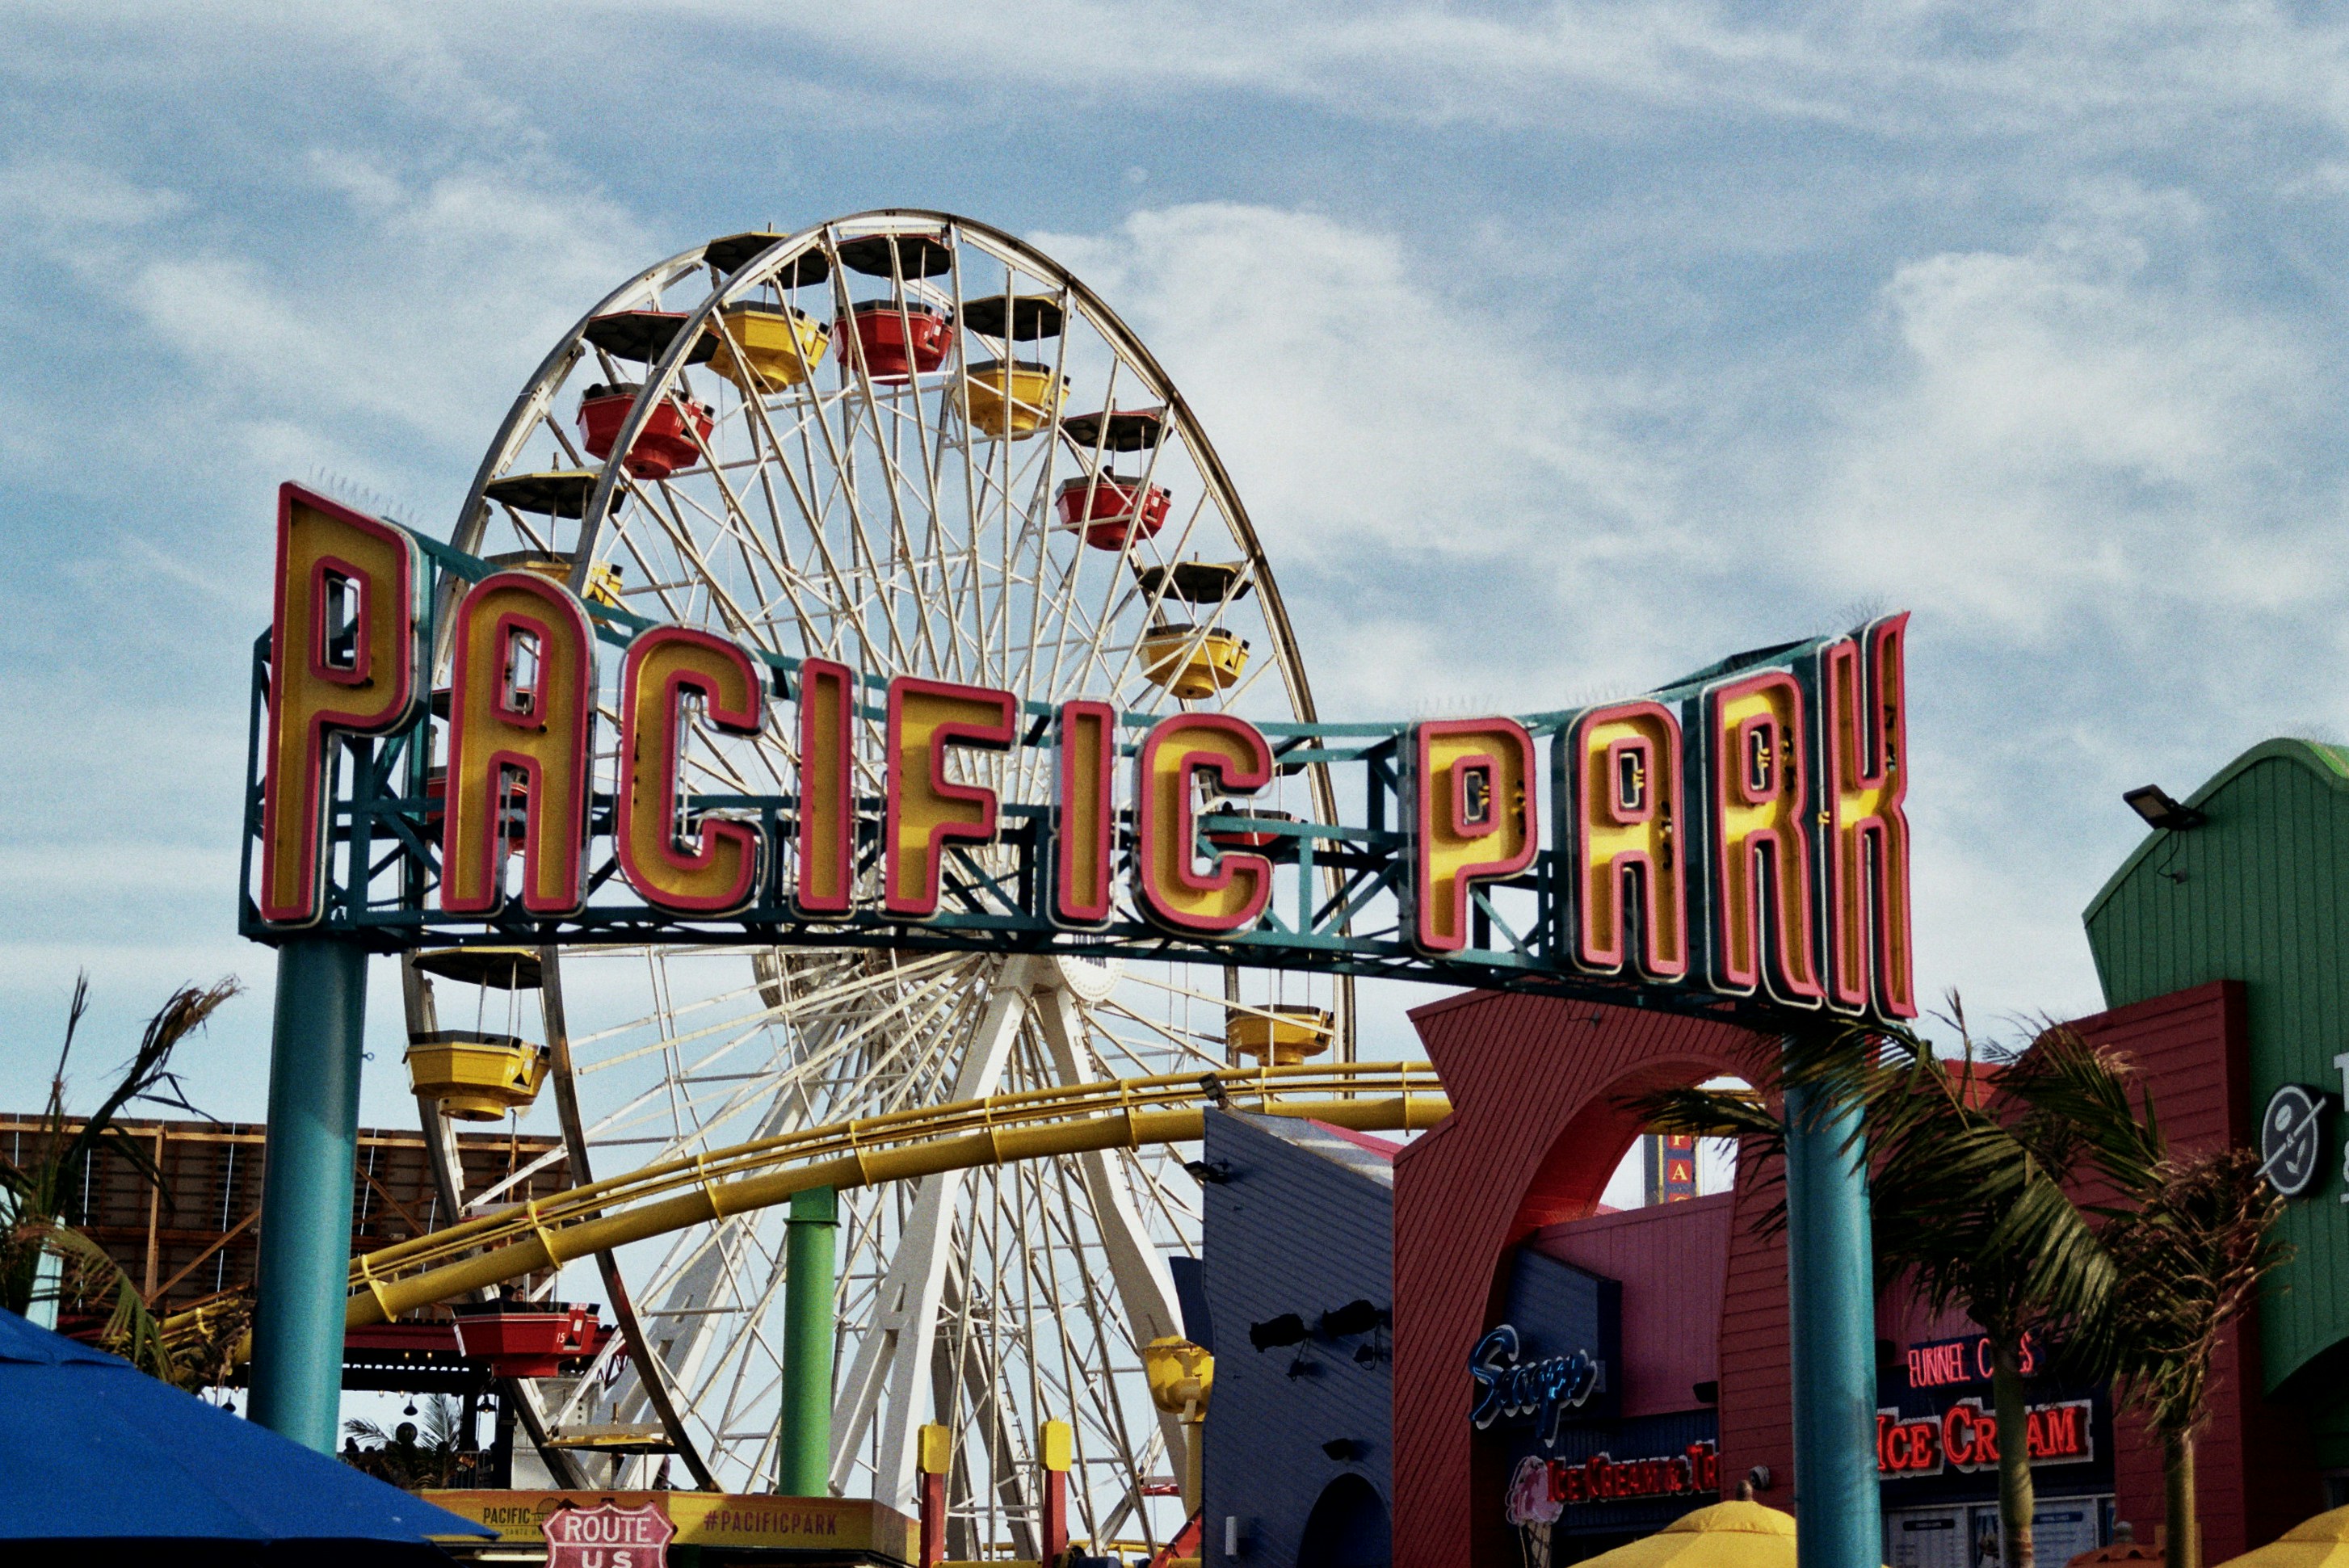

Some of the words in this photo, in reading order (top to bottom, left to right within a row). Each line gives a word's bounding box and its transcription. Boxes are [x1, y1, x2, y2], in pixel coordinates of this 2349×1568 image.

[260, 480, 1275, 935] PACIFIC
[1410, 611, 1918, 1023] PARK
[557, 1332, 565, 1343] 15
[1908, 1342, 1971, 1389] FUNNEL
[1942, 1404, 2086, 1465] CRAM
[483, 1507, 531, 1524] PACIFIC
[565, 1515, 652, 1543] ROUTE
[704, 1510, 838, 1536] #PACIFICPARK
